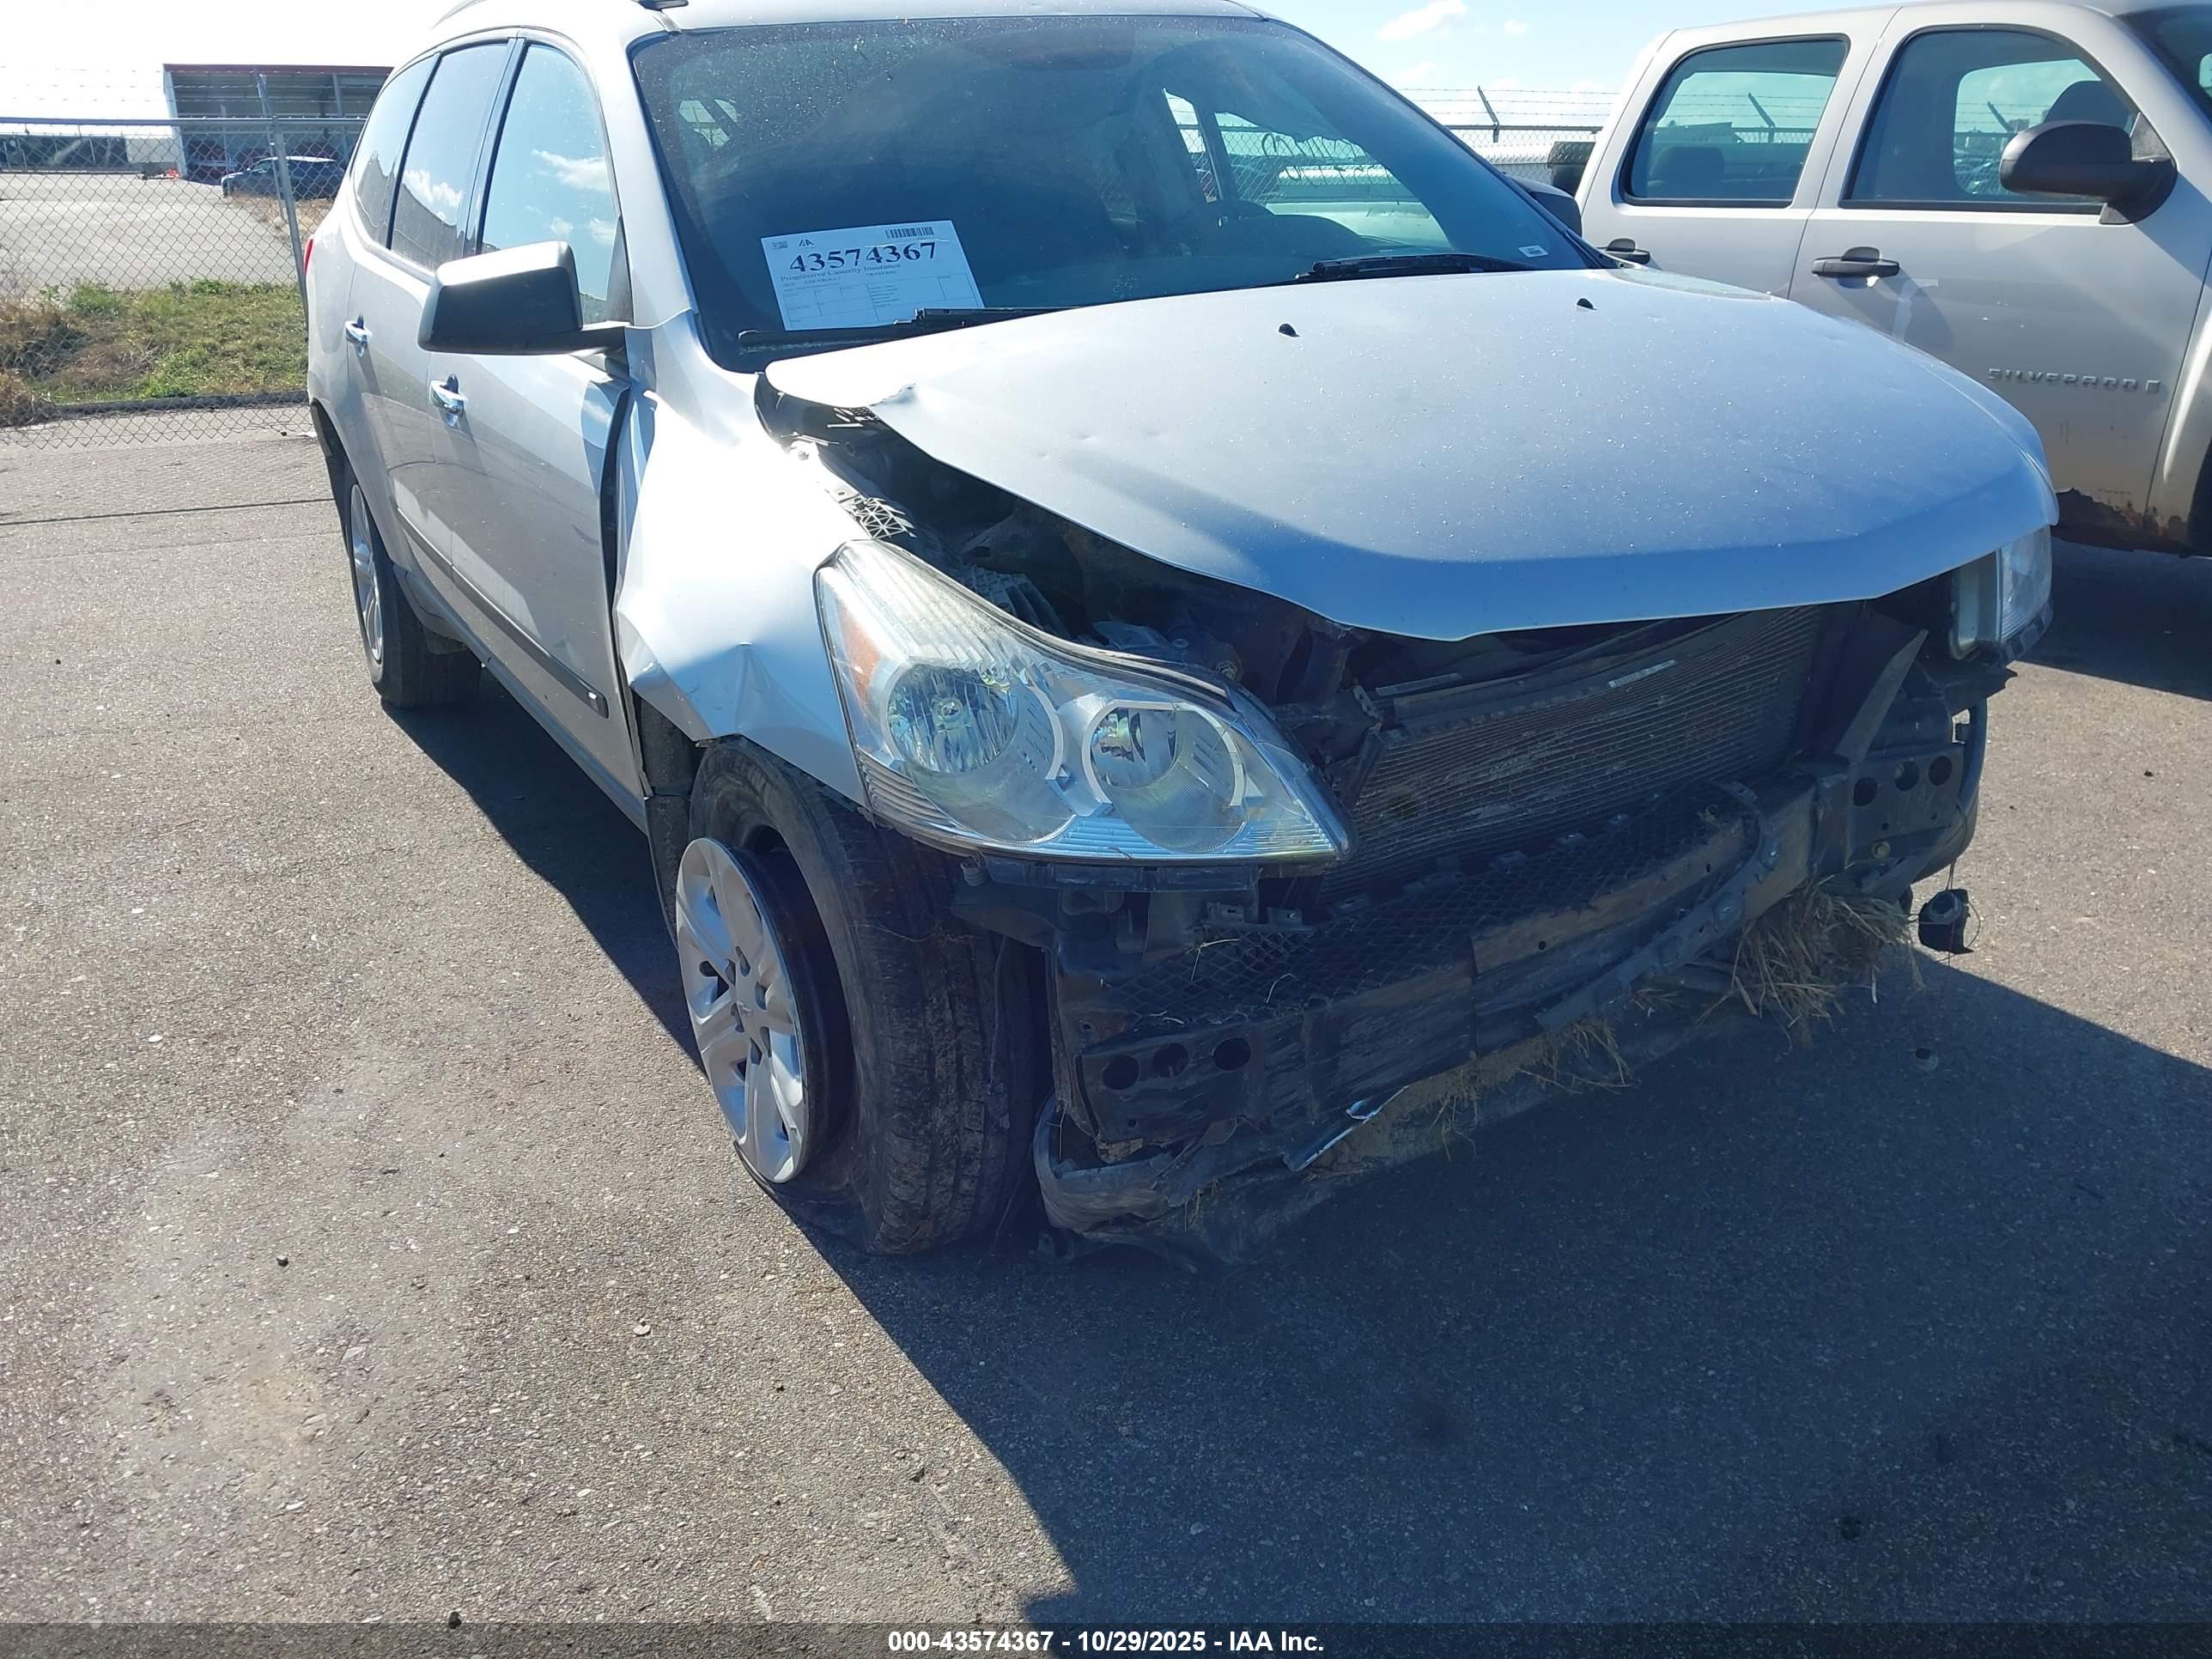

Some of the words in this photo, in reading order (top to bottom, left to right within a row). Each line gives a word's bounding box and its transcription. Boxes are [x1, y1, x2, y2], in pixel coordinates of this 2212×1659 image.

[789, 241, 936, 271] 43574367
[780, 271, 826, 282] Progressive
[827, 266, 861, 276] Casualty
[1988, 368, 2137, 390] SILVERADO
